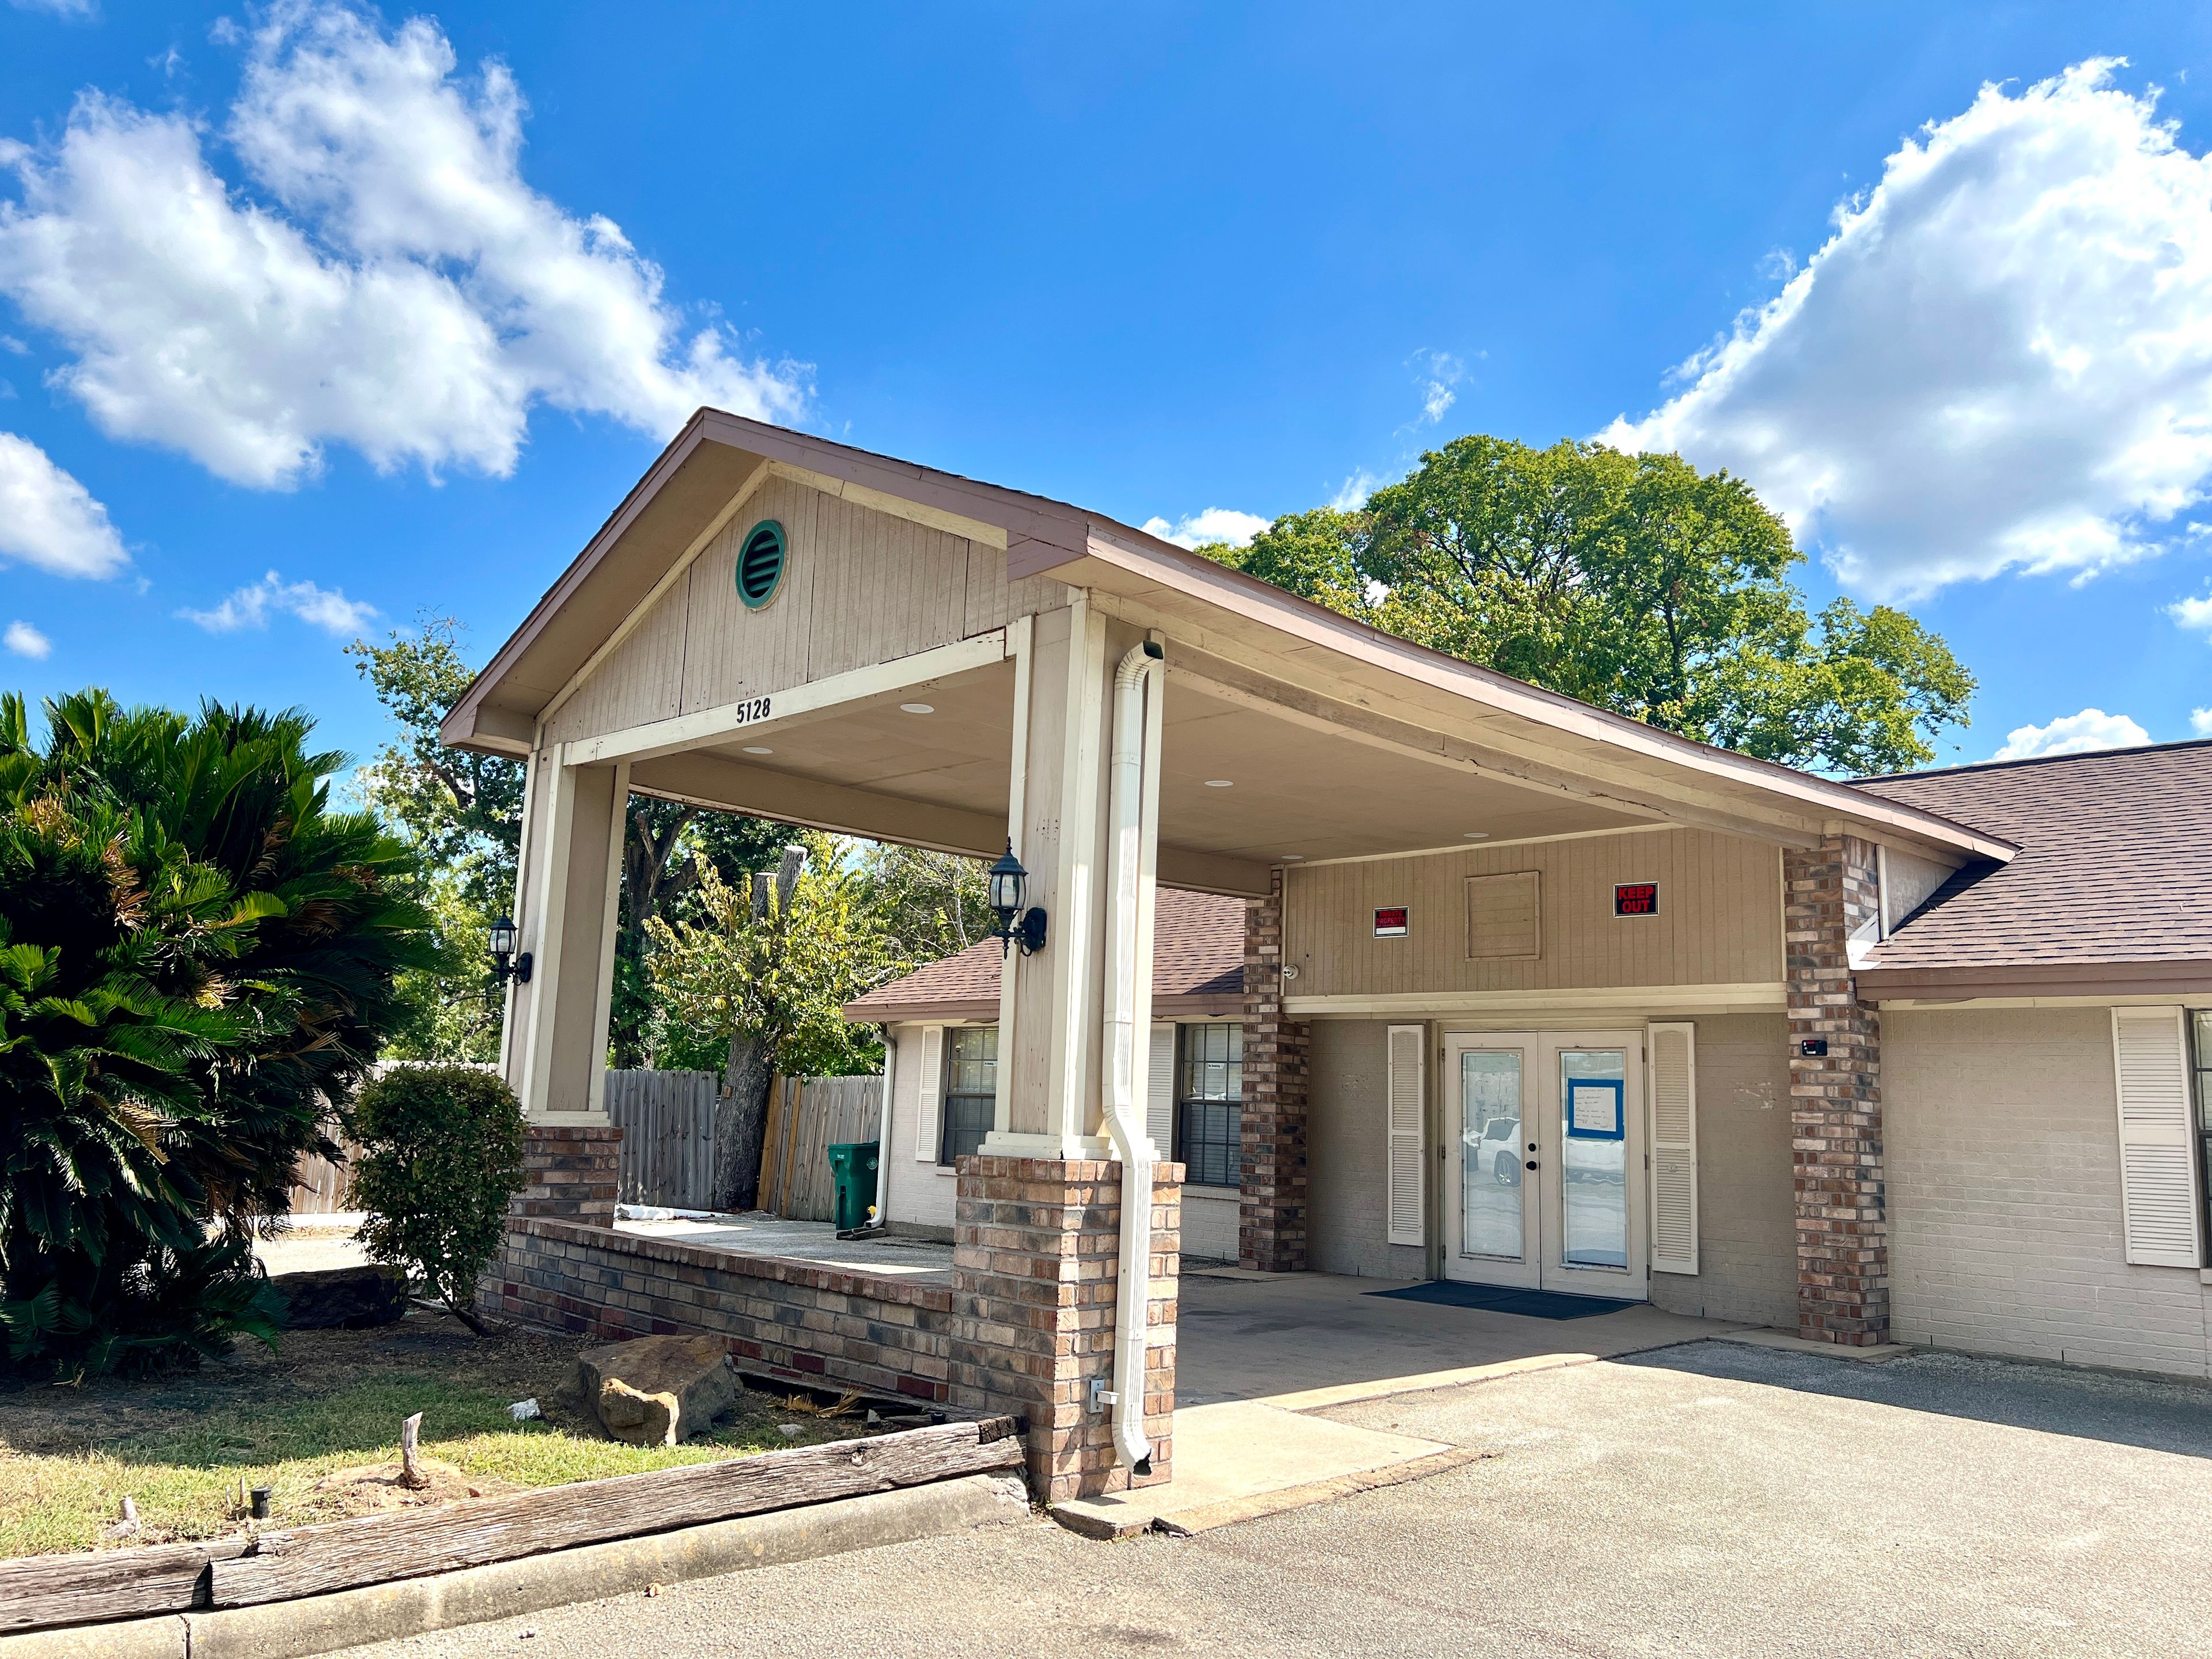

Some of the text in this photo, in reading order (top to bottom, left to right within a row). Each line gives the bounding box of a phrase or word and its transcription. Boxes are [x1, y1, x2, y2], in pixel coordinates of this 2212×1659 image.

[737, 698, 771, 724] 5128
[1618, 886, 1654, 900] KEEP
[1622, 900, 1650, 913] OUT
